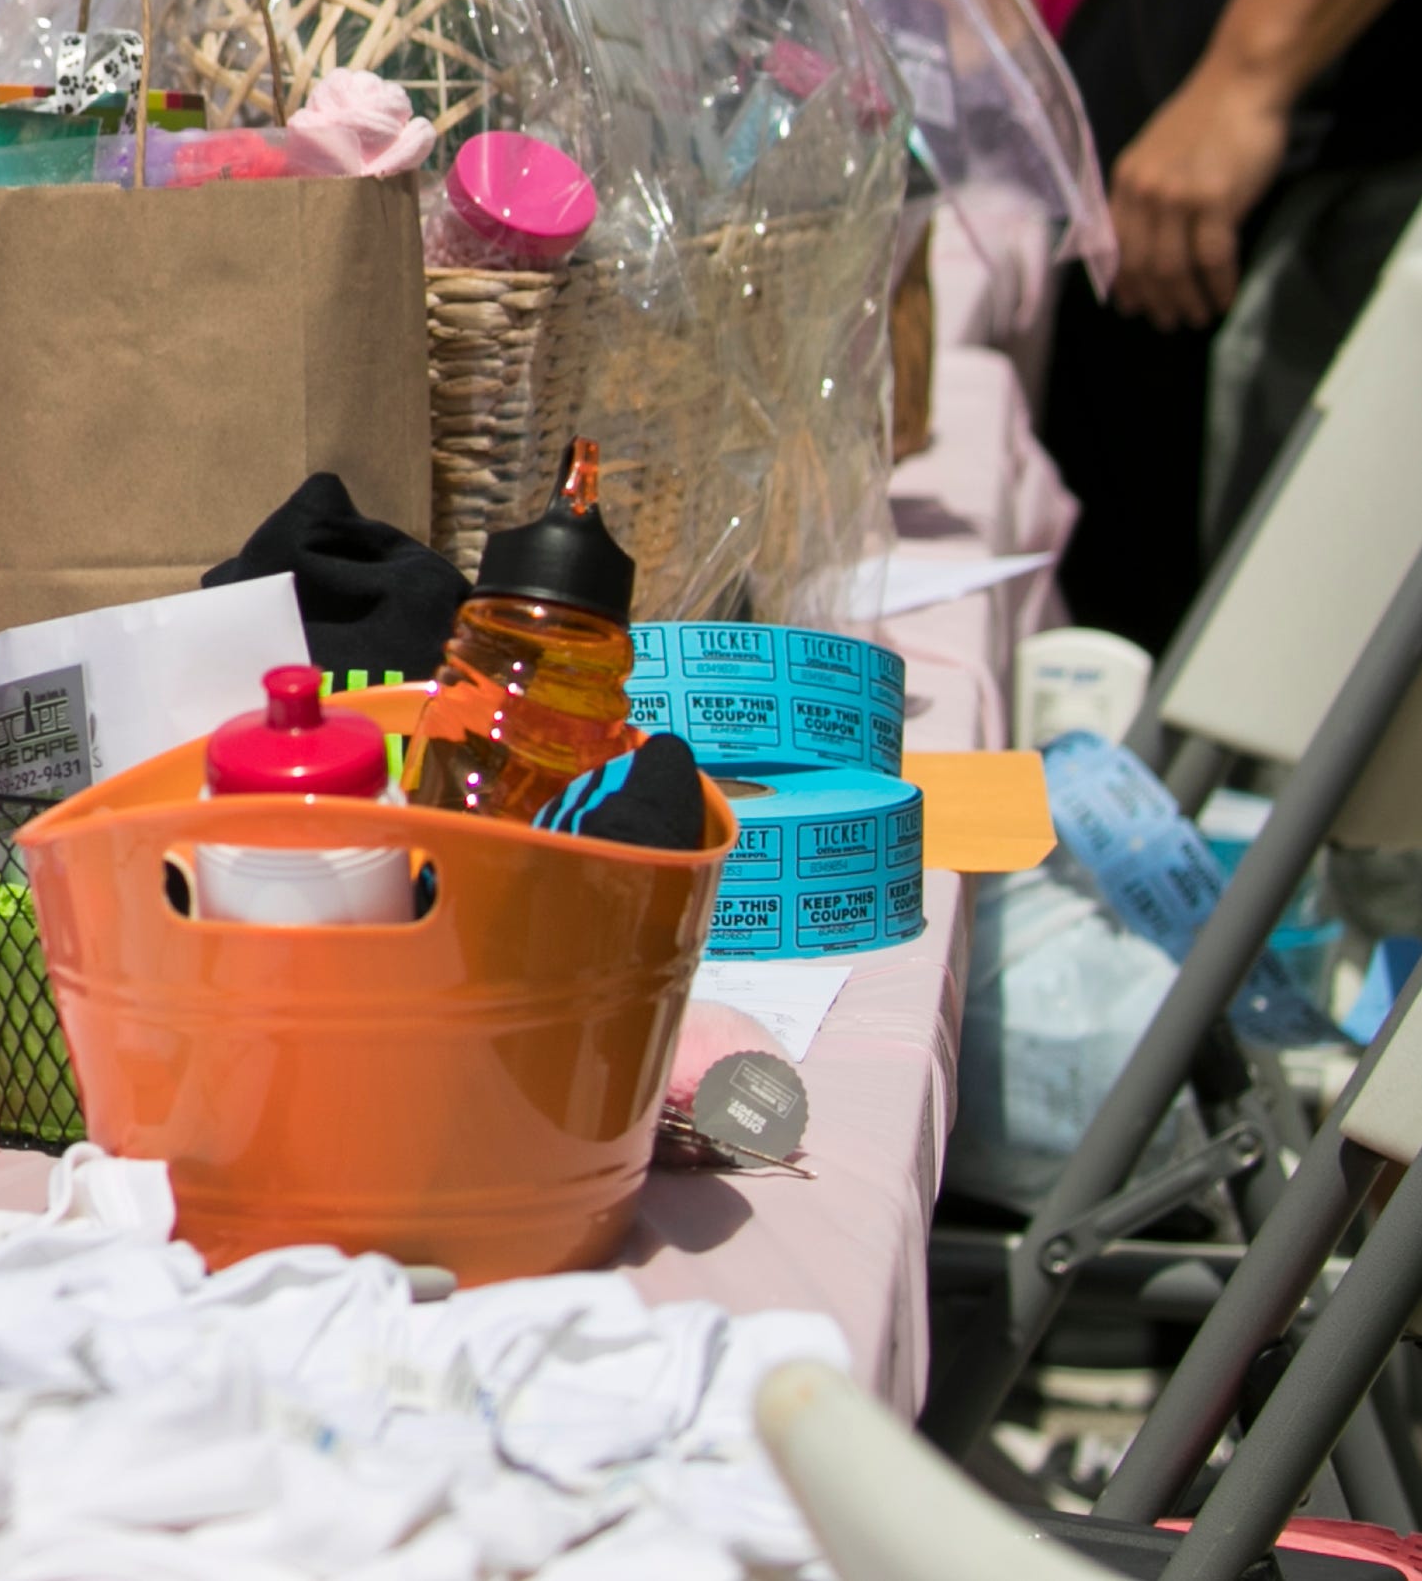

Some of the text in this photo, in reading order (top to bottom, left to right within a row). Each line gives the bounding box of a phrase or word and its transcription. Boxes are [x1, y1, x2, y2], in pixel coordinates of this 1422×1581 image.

[697, 630, 761, 651] TICKET
[802, 636, 853, 663] TICKET
[692, 695, 775, 712] KEEP THIS
[702, 709, 767, 724] COUPON
[796, 702, 860, 726] KEEP THIS
[804, 718, 855, 736] COUPON
[22, 734, 79, 764] CAPE
[737, 829, 769, 850] KET
[813, 822, 868, 846] TICKET
[716, 899, 778, 912] EP THIS
[803, 891, 874, 910] KEEP THIS
[711, 914, 768, 926] OUPON
[811, 906, 867, 923] COUPON
